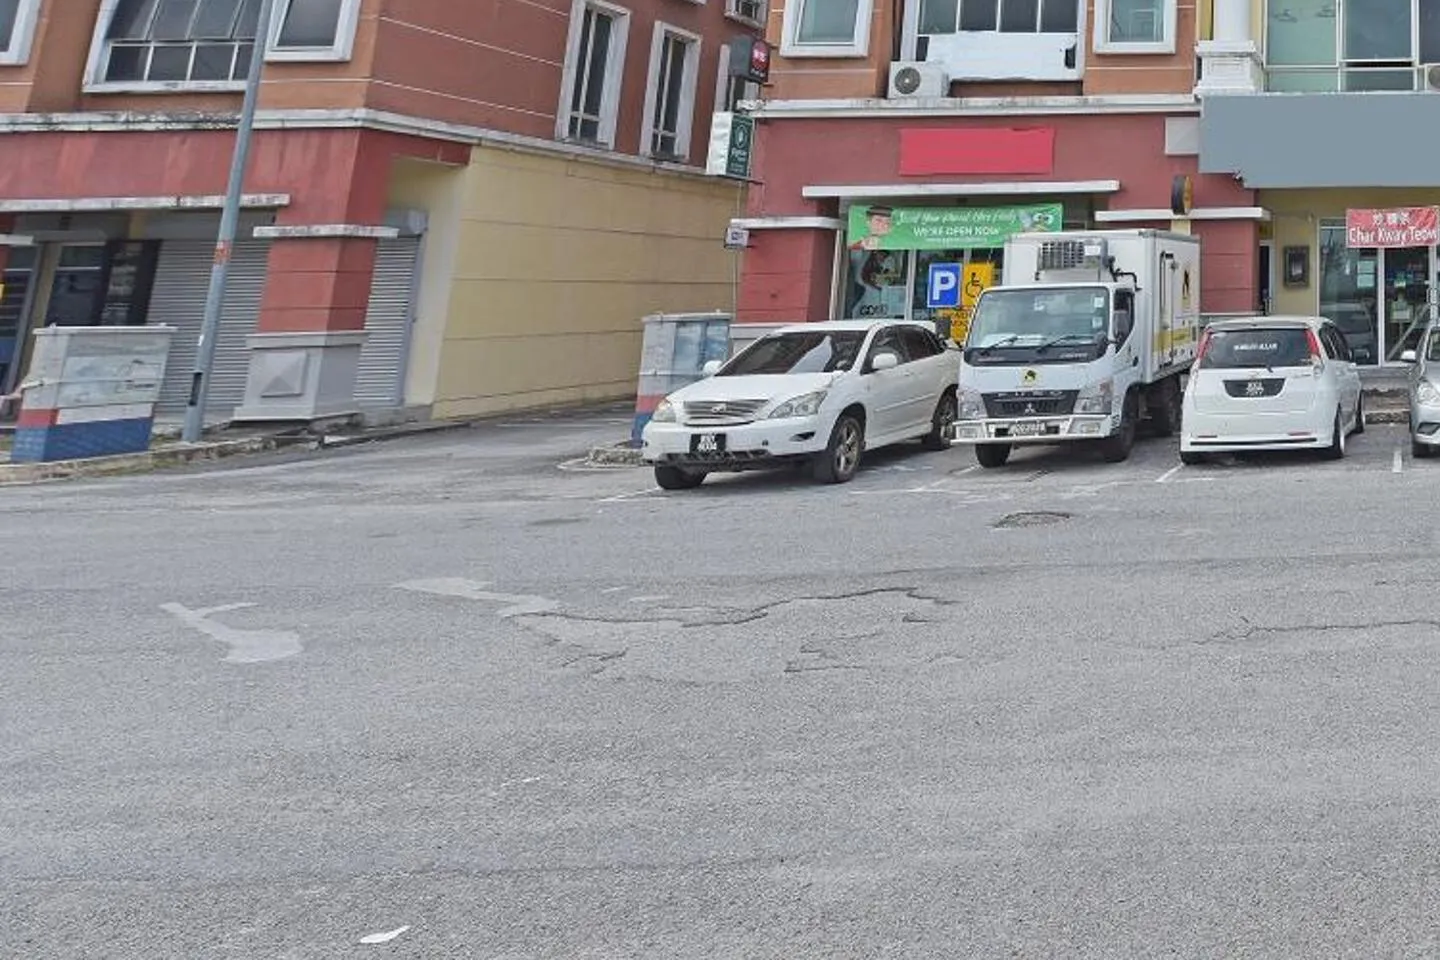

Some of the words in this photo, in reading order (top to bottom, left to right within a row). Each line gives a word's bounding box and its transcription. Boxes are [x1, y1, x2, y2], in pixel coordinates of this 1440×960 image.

[1349, 226, 1374, 243] Char
[1409, 226, 1437, 241] Teow
[932, 271, 956, 300] P
